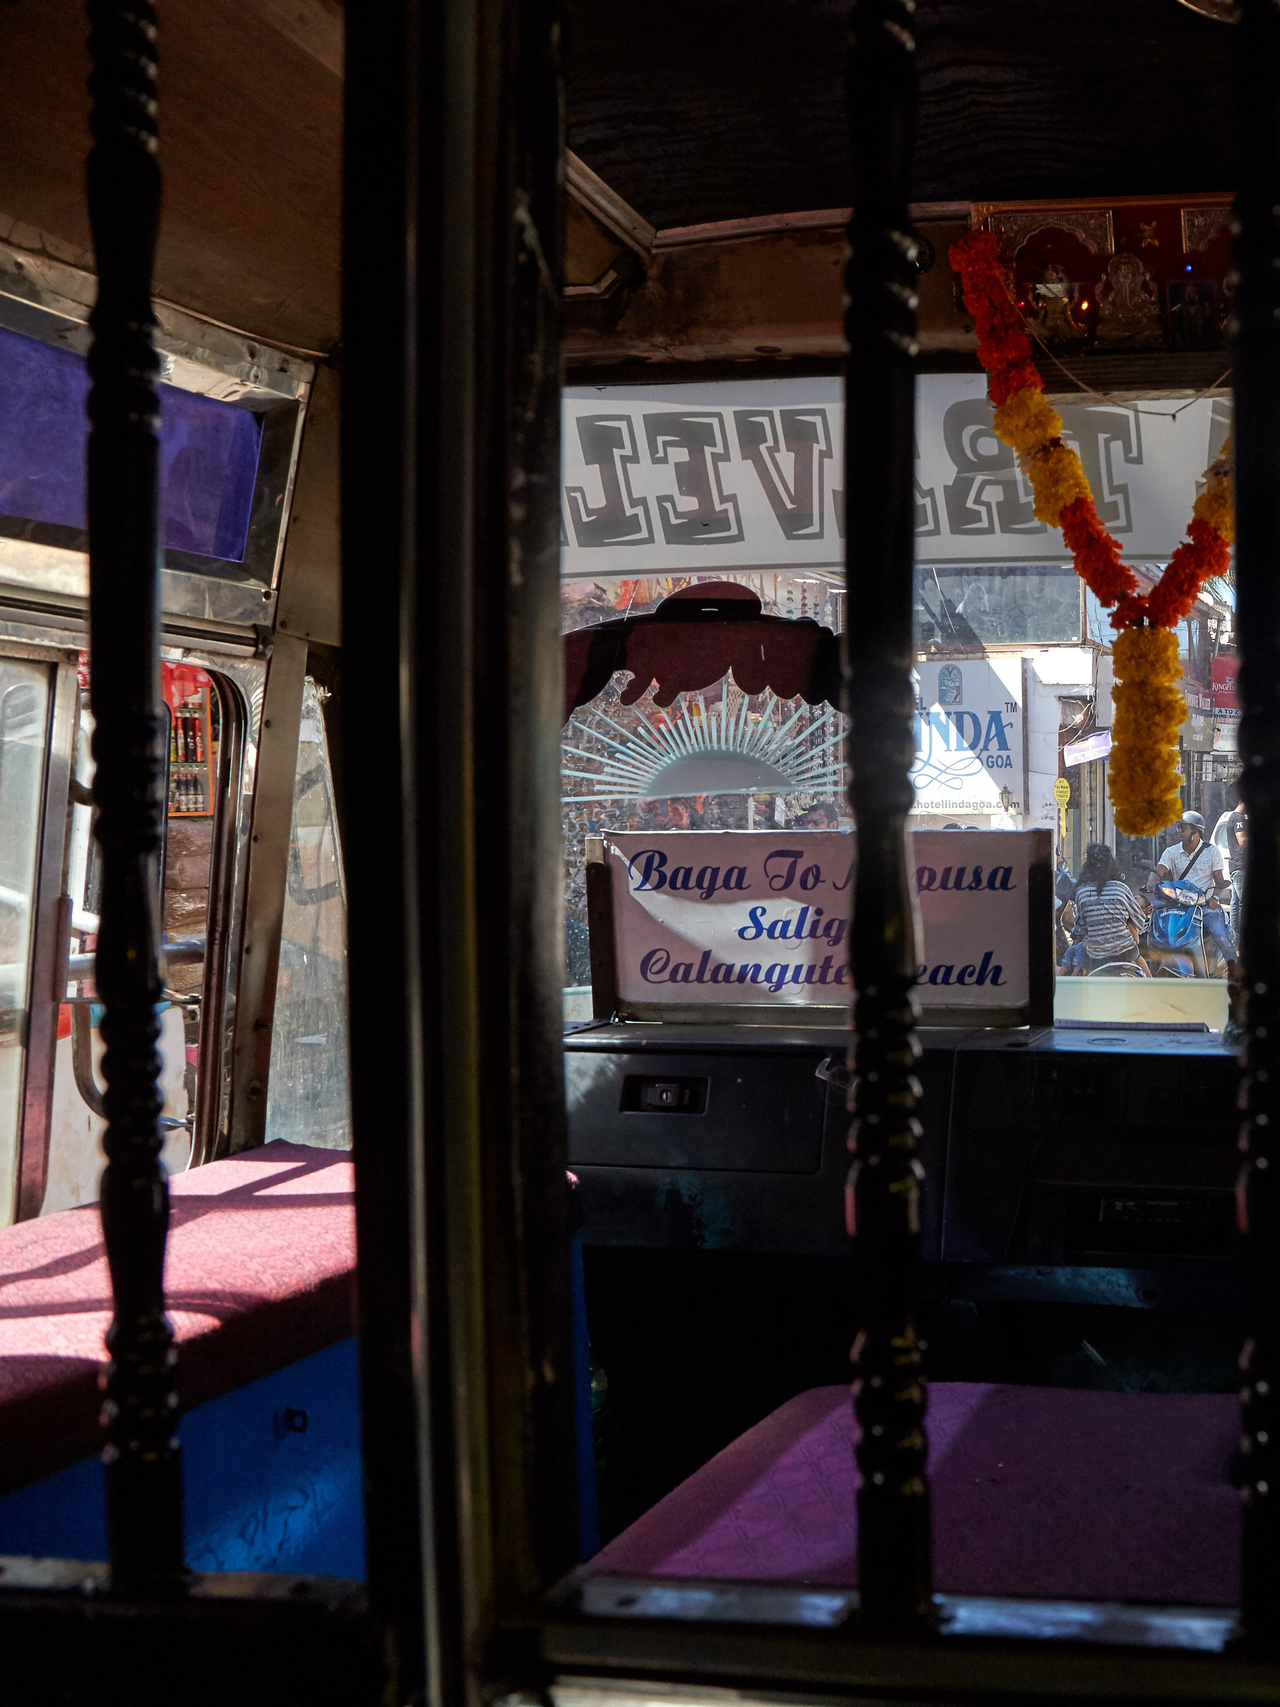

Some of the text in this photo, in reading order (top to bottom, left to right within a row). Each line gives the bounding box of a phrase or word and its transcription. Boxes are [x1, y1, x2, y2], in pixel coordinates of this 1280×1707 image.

[1005, 702, 1018, 713] TM
[1212, 683, 1237, 691] KINGFIS
[913, 710, 1014, 752] INDA
[986, 755, 1013, 769] GOA
[628, 849, 752, 900] Baga
[763, 849, 826, 891] To
[737, 905, 849, 948] Salig
[640, 947, 1008, 992] Calangute each
